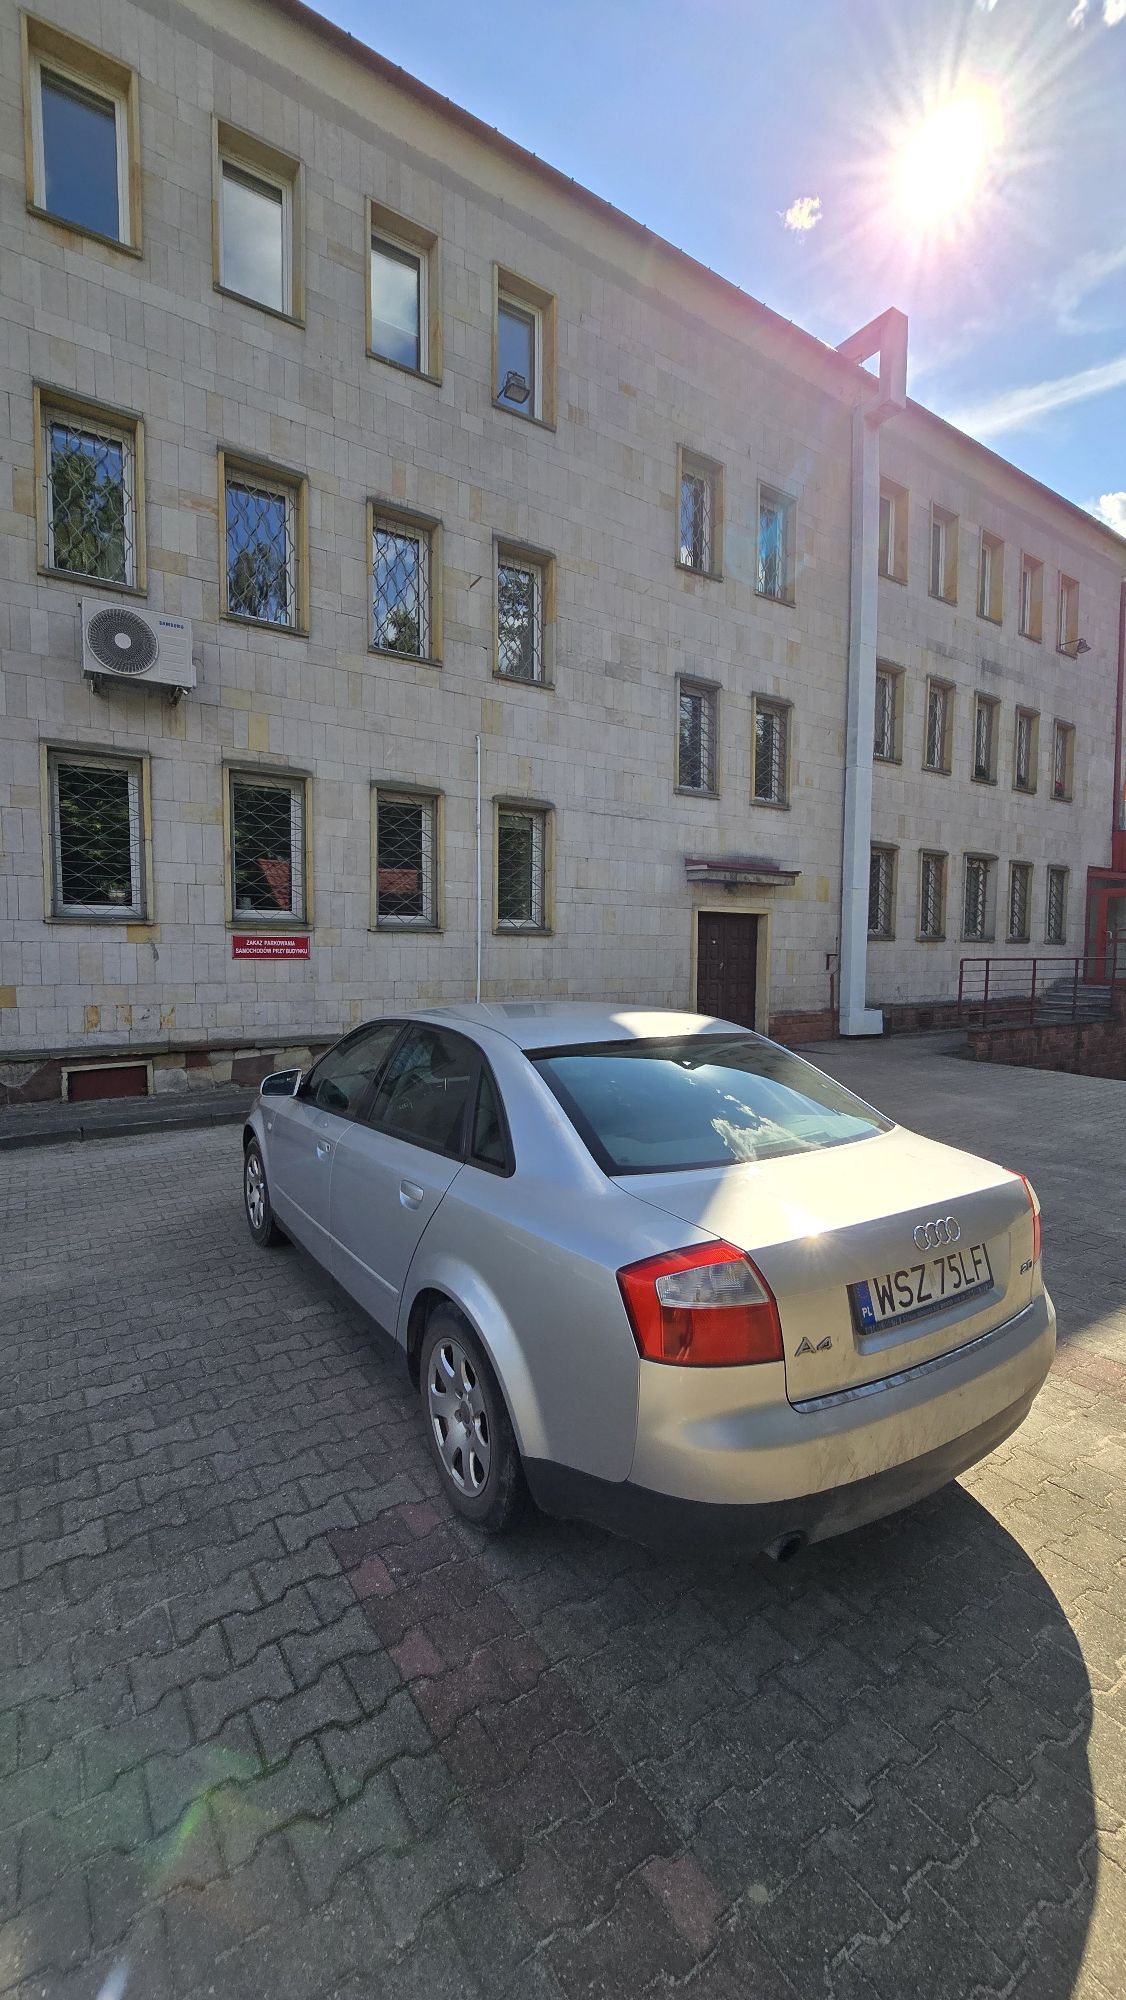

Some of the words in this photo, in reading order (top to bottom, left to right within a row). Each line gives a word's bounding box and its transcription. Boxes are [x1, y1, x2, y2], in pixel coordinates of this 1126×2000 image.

[159, 621, 184, 630] SAMSUNG
[872, 1264, 932, 1315] WSZ
[933, 1244, 982, 1295] 75LF
[861, 1306, 874, 1318] PL
[794, 1335, 833, 1357] A4
